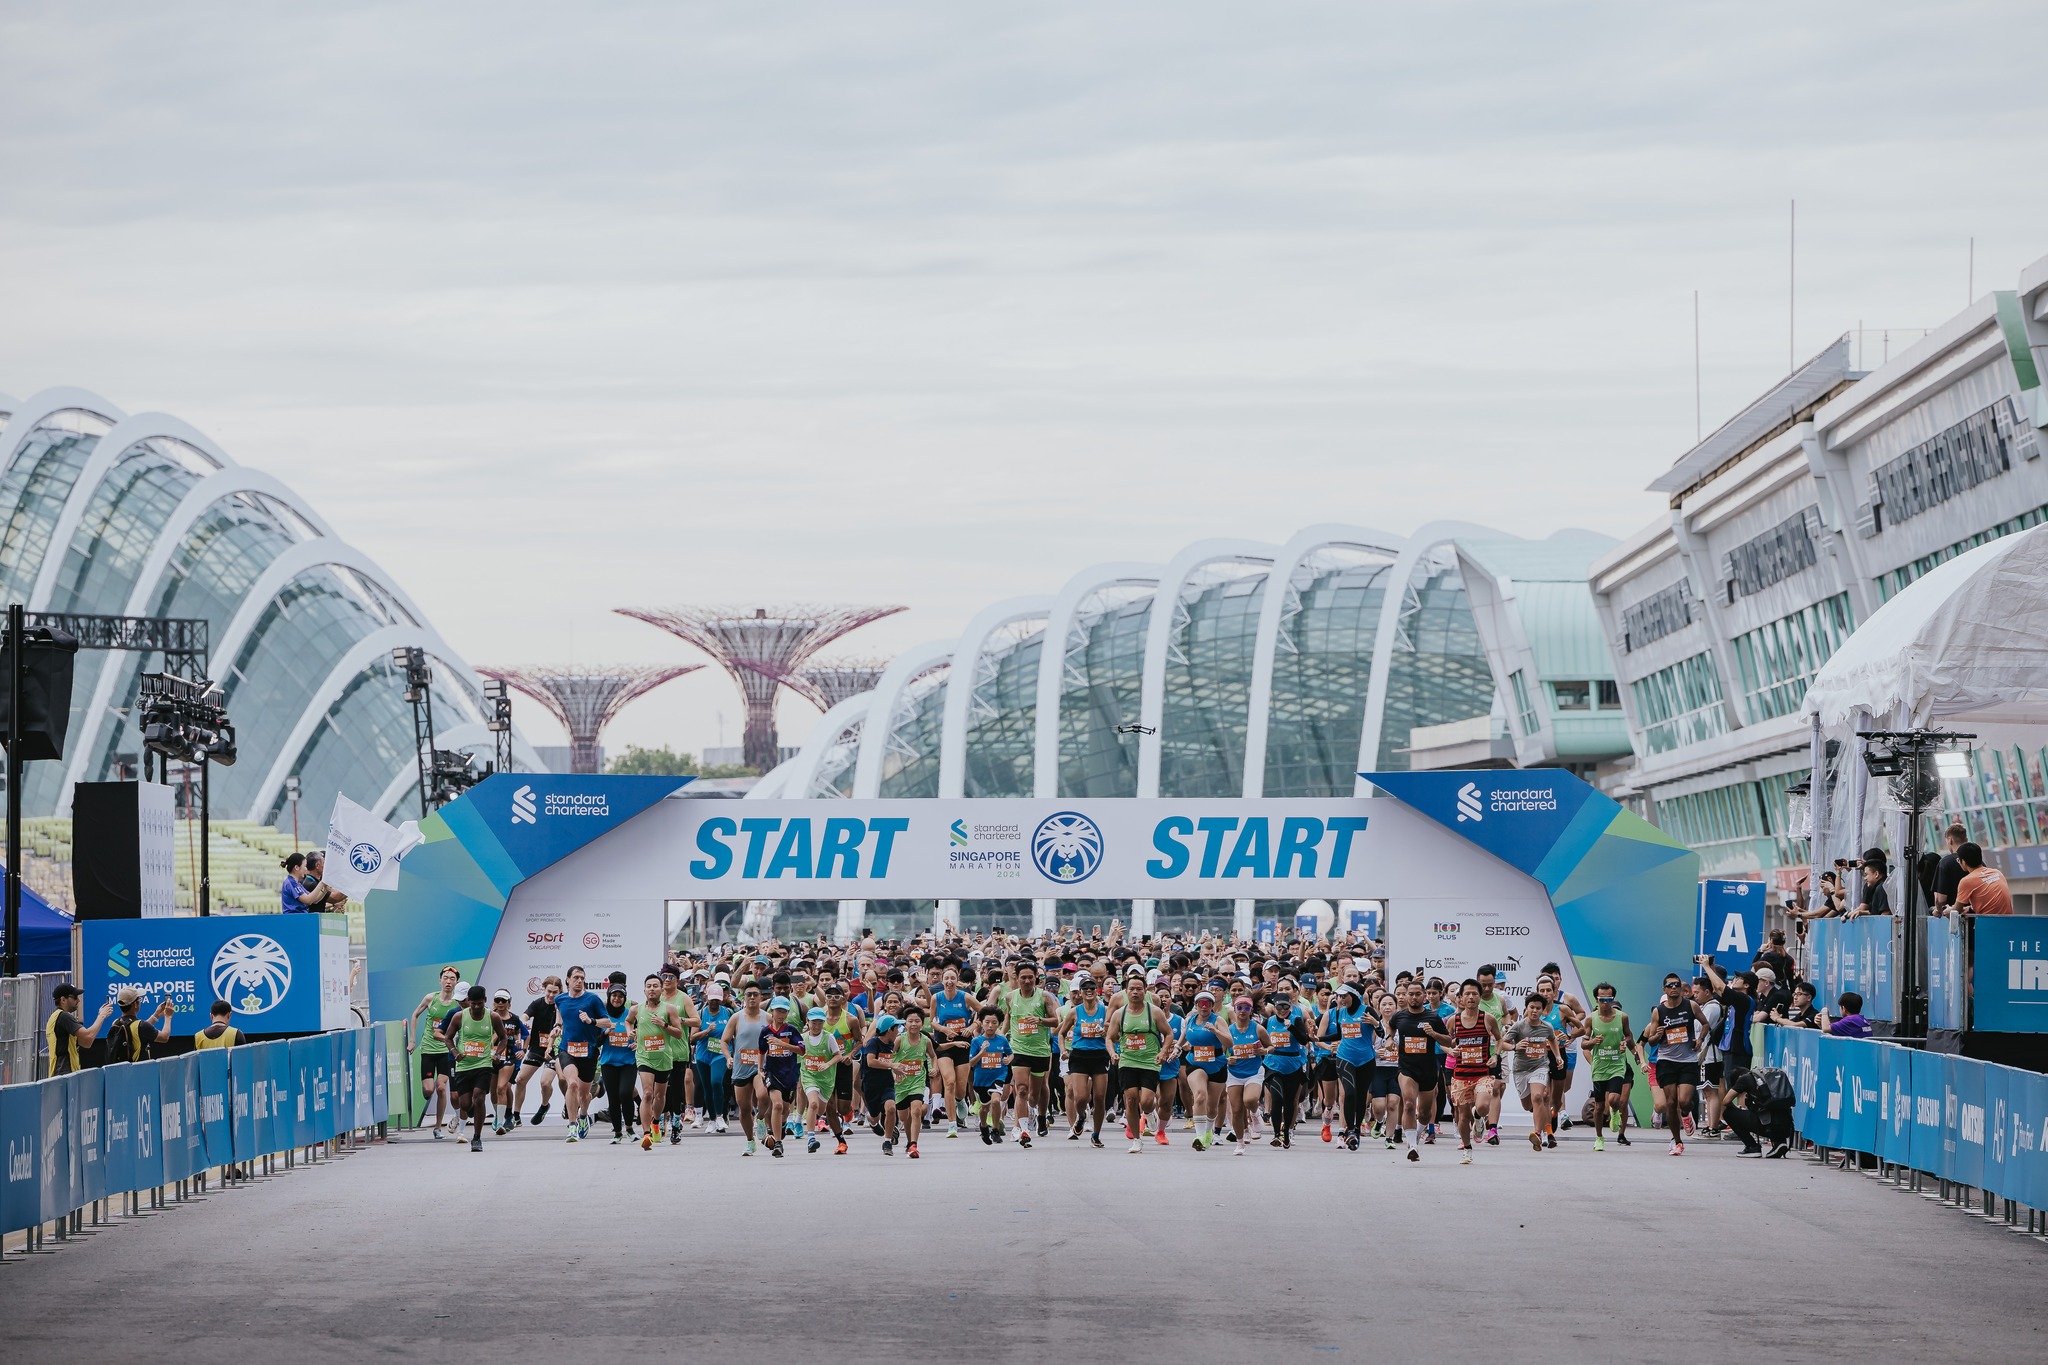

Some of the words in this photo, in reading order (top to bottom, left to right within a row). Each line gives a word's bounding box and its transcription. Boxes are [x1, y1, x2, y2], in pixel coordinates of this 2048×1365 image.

[545, 793, 606, 805] standard
[1490, 787, 1553, 800] standard
[545, 804, 609, 816] chartered
[1490, 798, 1557, 811] chartered
[973, 823, 1018, 832] standard
[973, 831, 1021, 841] chartered
[689, 816, 910, 880] START
[1146, 815, 1369, 880] START
[949, 851, 1021, 862] SINGAPORE
[949, 862, 1021, 870] MARATHON
[996, 870, 1021, 878] 2024
[1485, 926, 1530, 936] SEIKO
[1716, 912, 1749, 953] A
[585, 937, 598, 945] SG
[2009, 940, 2041, 952] THE
[137, 947, 191, 959] standard
[137, 957, 195, 968] chartered
[1425, 957, 1442, 969] tcs
[174, 1004, 195, 1013] 024
